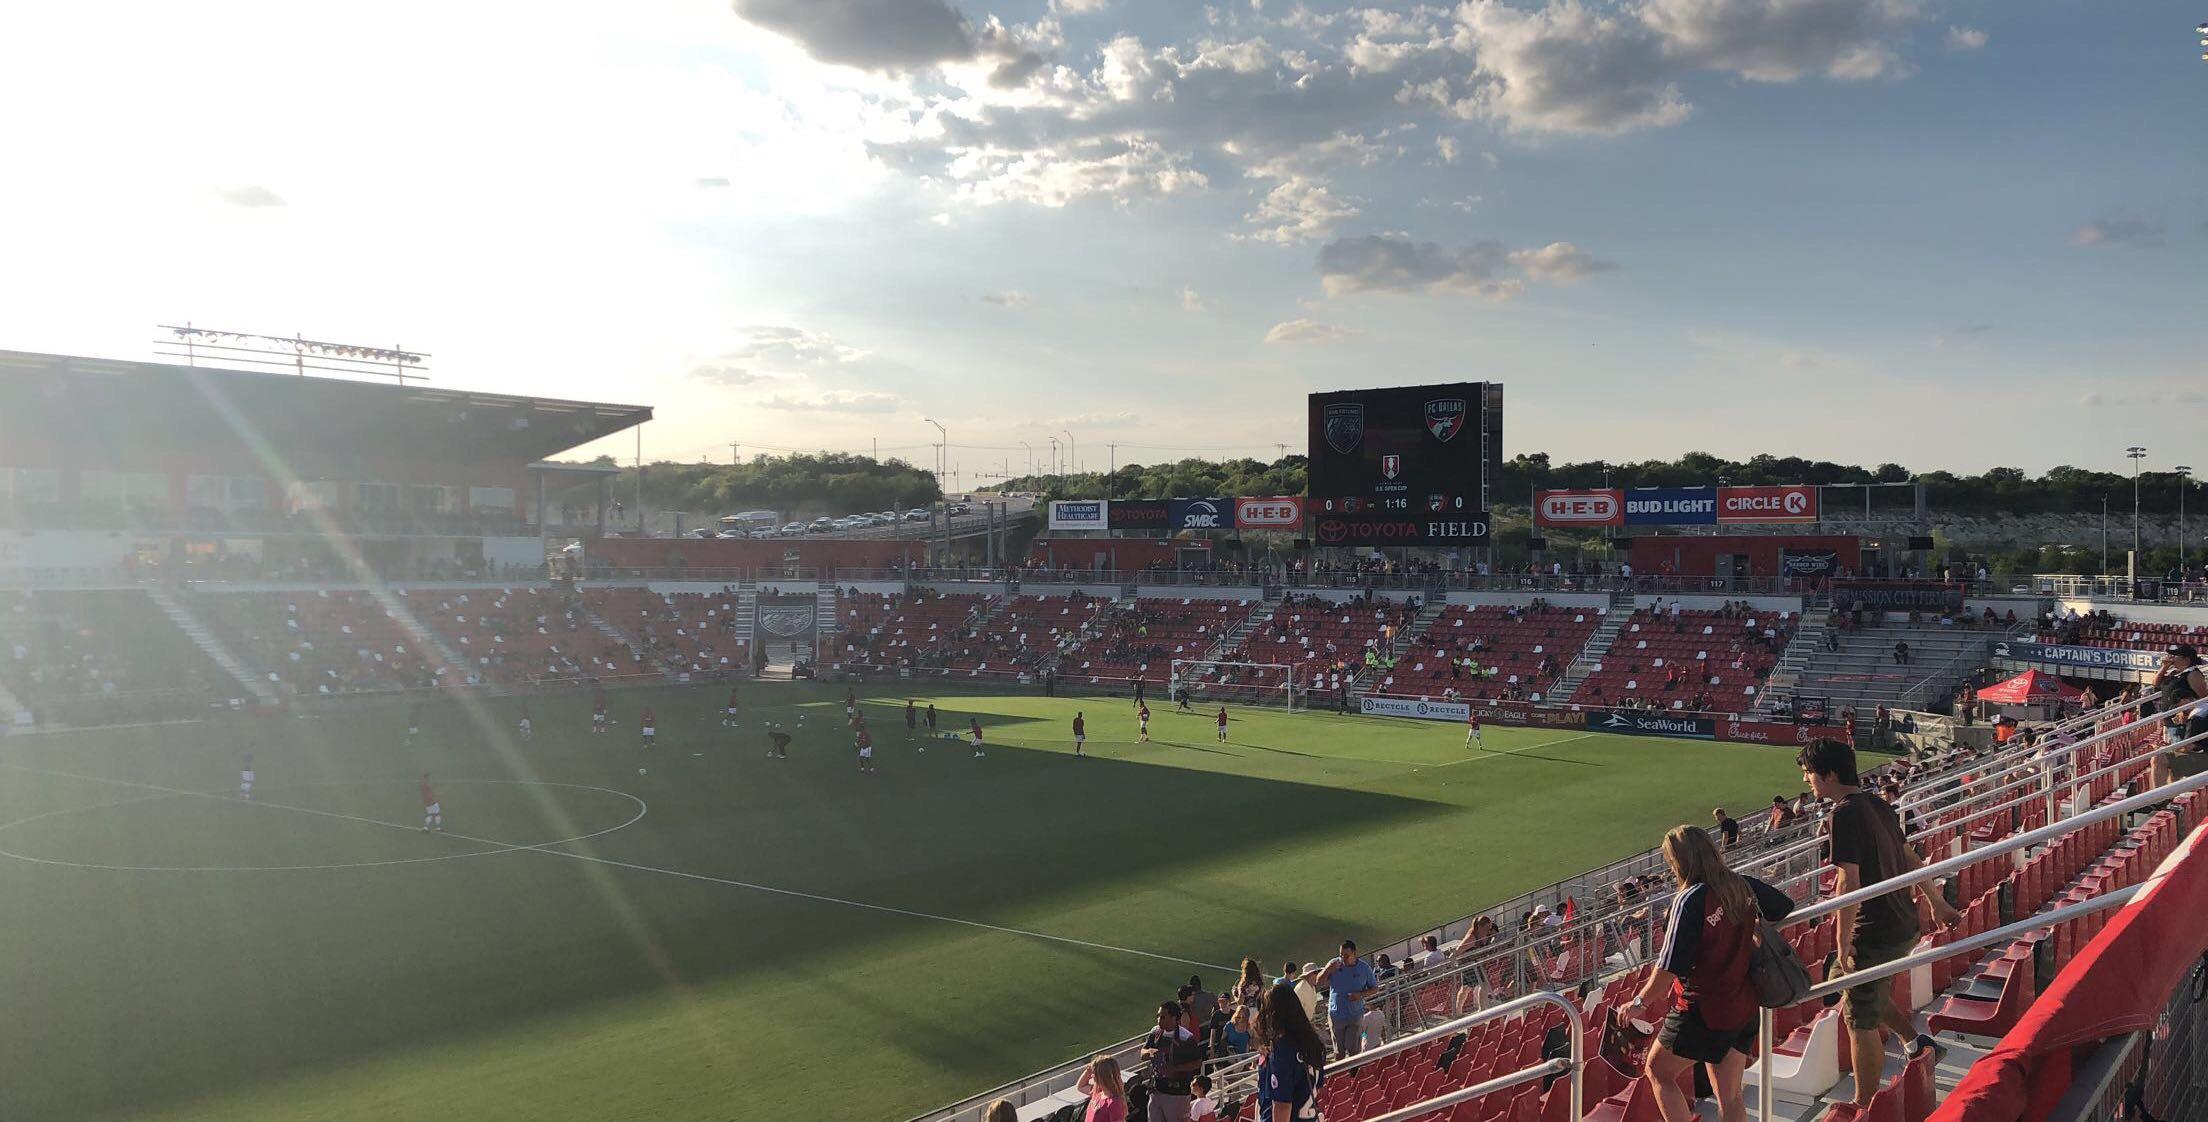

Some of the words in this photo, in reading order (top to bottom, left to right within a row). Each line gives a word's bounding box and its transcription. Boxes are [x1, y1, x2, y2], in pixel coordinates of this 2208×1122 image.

[1428, 403, 1436, 414] FC
[1438, 401, 1463, 412] DALLAS
[1060, 504, 1097, 512] METHODIST
[1325, 499, 1332, 511] 0
[1385, 498, 1407, 509] 1:16
[1455, 496, 1463, 508] 0
[1626, 501, 1662, 513] BUD
[1664, 499, 1715, 513] LIGHT
[1726, 497, 1781, 510] CIRCLE
[1787, 493, 1807, 512] K
[1058, 512, 1100, 520] HEALTHCARE
[1126, 509, 1168, 520] TOYOTA
[1183, 514, 1219, 528] SWBC
[1350, 523, 1419, 537] TOYOTA
[1428, 521, 1487, 537] FIELD
[2044, 648, 2101, 663] CAPTAIN'S
[2105, 652, 2153, 667] CORNER
[1375, 702, 1410, 711] RECYCLE
[1429, 706, 1466, 715] RECYCLE
[1504, 710, 1527, 720] EAGLE
[1636, 717, 1697, 732] SeaWorld
